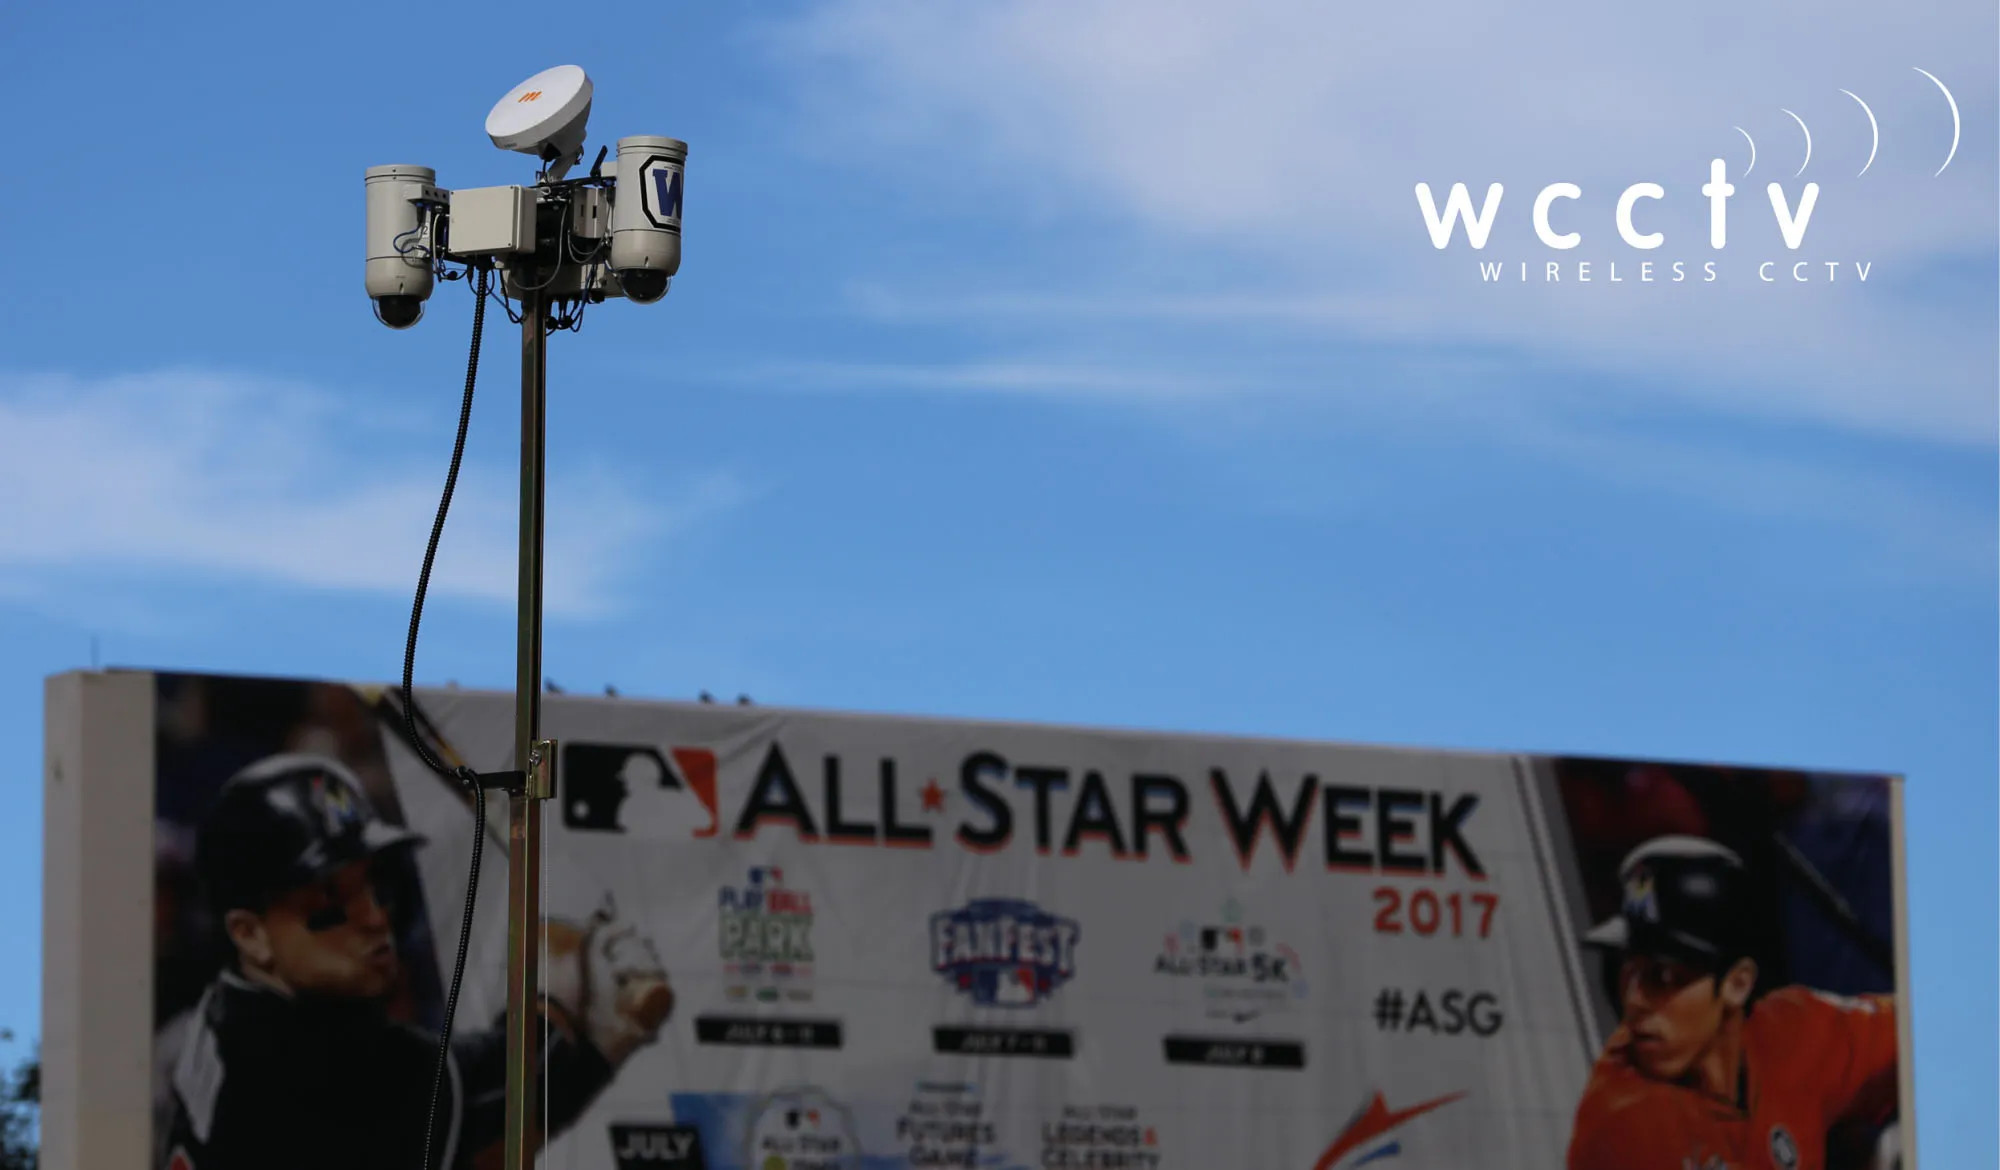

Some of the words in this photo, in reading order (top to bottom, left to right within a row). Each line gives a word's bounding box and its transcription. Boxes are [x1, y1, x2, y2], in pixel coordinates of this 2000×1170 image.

[954, 749, 1193, 864] STAR
[1209, 766, 1490, 881] WEEK
[719, 913, 815, 961] PARK
[1372, 887, 1501, 939] 2017
[932, 914, 1080, 978] FANFEST
[1373, 988, 1505, 1038] #ASG
[619, 1132, 696, 1160] JULY
